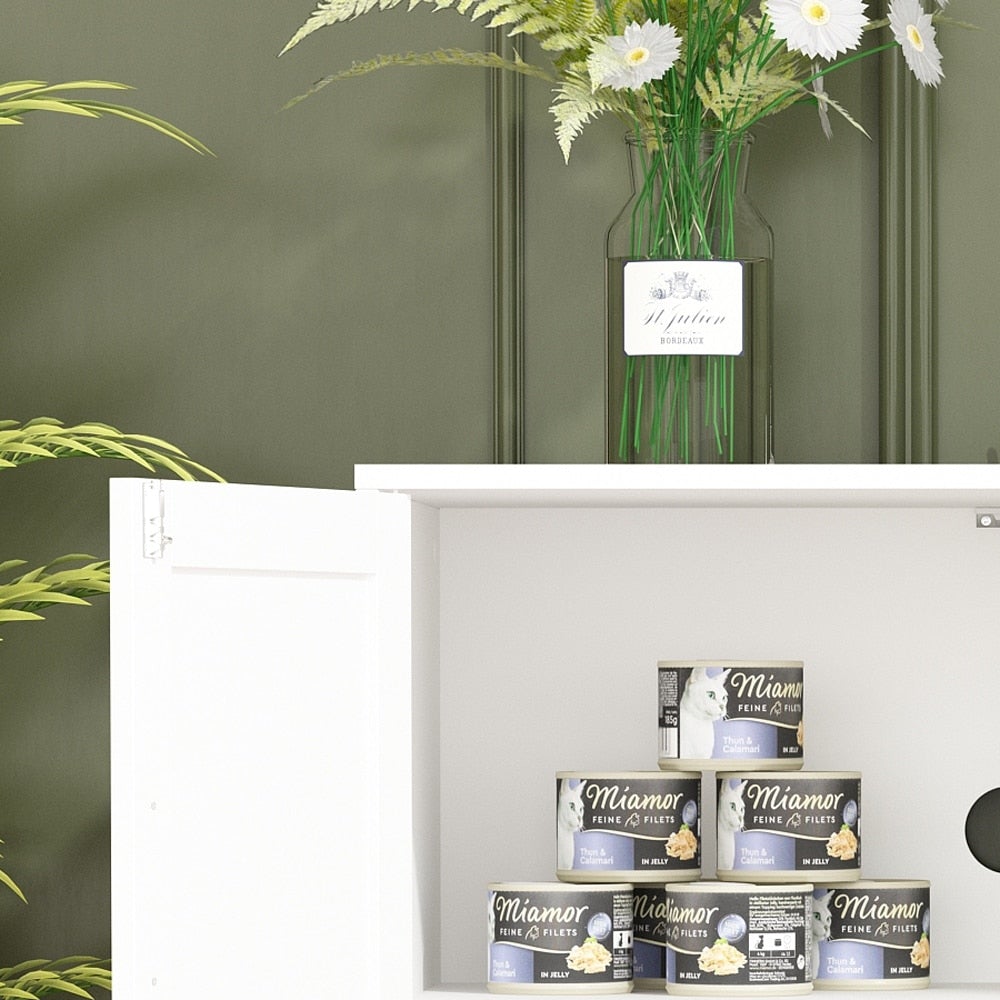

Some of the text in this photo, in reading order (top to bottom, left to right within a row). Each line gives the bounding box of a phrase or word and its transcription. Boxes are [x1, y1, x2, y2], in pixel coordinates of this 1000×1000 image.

[660, 337, 704, 345] BORDEAUX
[738, 704, 767, 712] FEINE
[722, 736, 753, 746] Thun &
[722, 744, 760, 753] Calamari
[586, 783, 684, 810] Miamor
[747, 783, 845, 810] Miamor
[592, 815, 675, 824] FEINE FILETS
[753, 815, 836, 824] FEINE FILETS
[740, 848, 767, 857] Thun &
[580, 855, 614, 865] Calamari
[740, 855, 775, 865] Calamari
[496, 896, 589, 923] Miamor
[834, 894, 923, 920] Miamor
[500, 928, 577, 937] FEINE FILETS
[634, 924, 650, 932] INE
[841, 924, 918, 933] FEINE FILETS
[680, 930, 708, 938] FILETS
[827, 964, 864, 974] Calamari
[550, 971, 570, 979] JELLY
